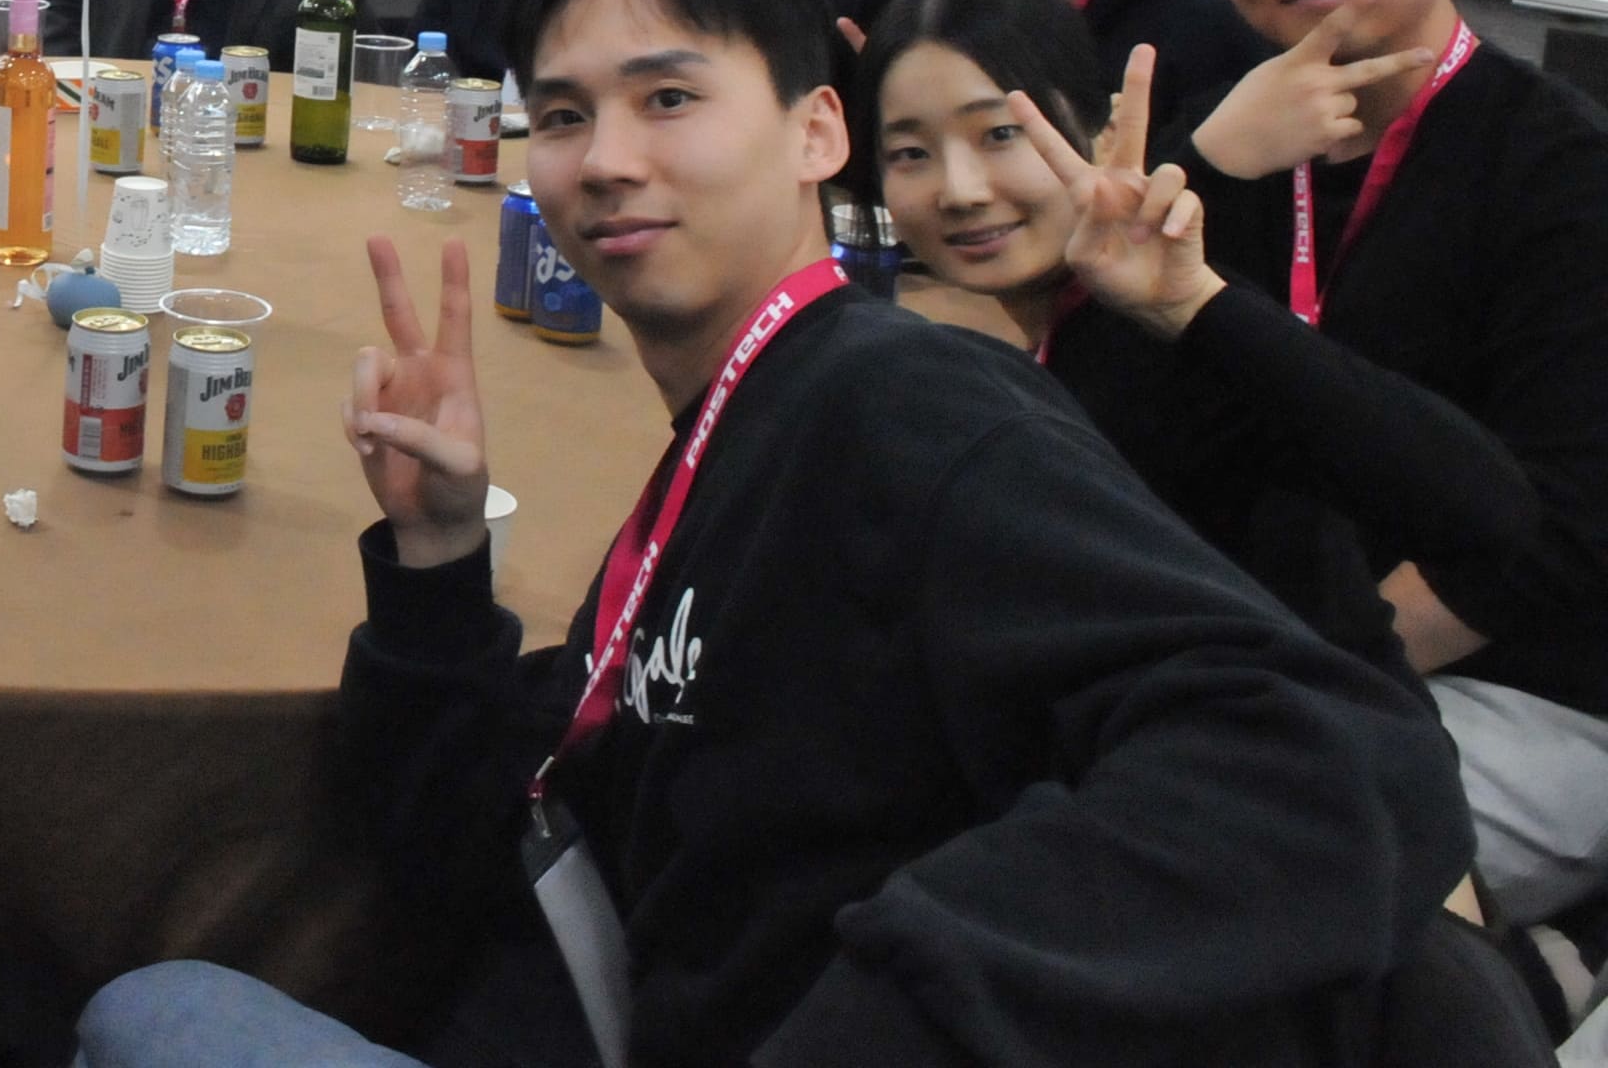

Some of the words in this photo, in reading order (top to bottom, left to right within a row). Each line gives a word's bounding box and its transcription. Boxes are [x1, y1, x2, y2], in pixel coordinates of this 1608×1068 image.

[1294, 163, 1310, 264] OSTECH
[200, 375, 232, 403] JIM
[685, 291, 795, 469] POSTECH
